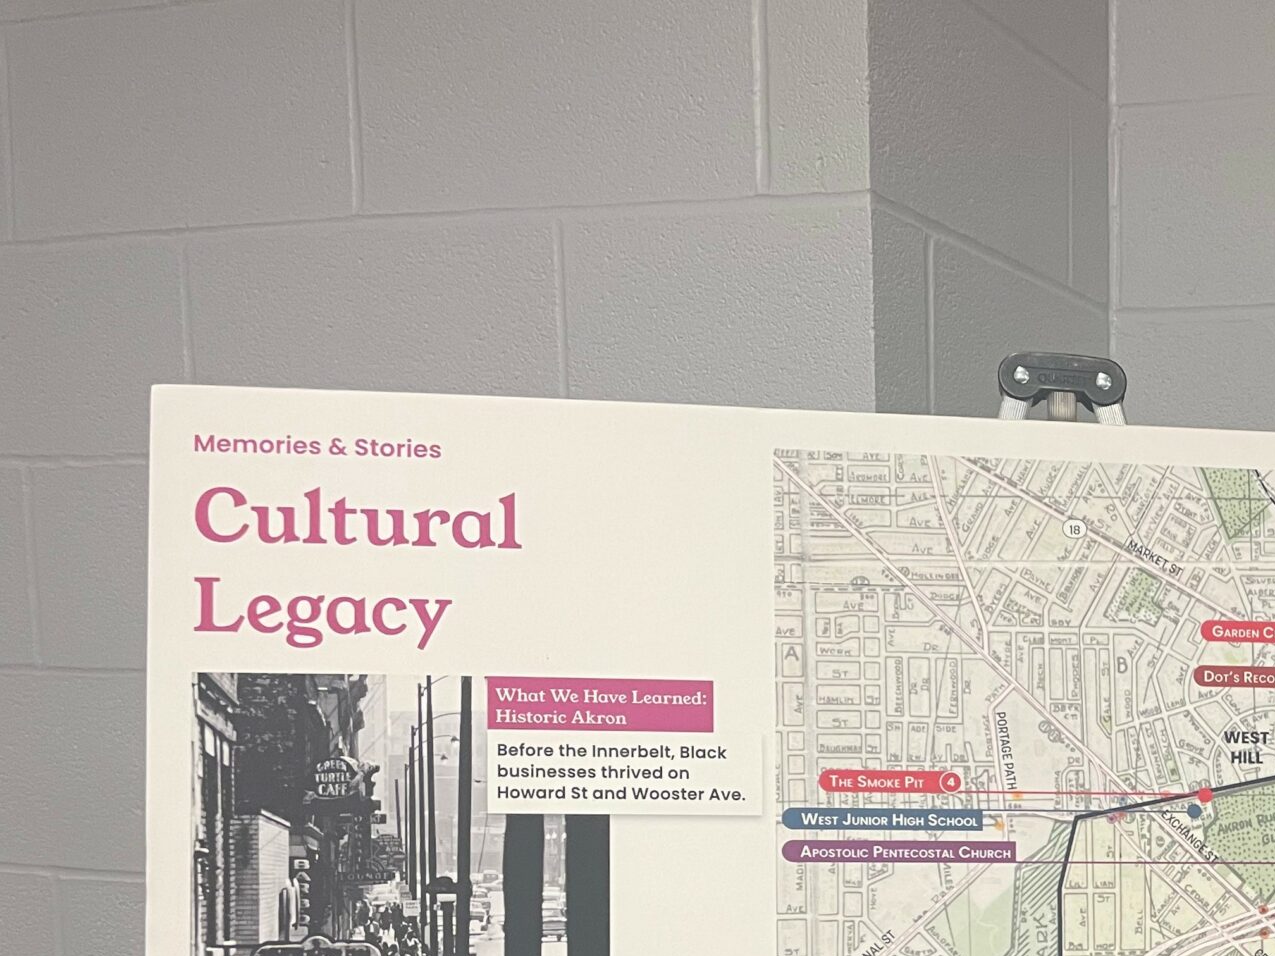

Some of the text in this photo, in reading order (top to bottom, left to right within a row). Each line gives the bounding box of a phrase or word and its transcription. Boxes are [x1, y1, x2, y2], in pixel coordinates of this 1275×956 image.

[194, 434, 442, 458] Memories & Stories
[195, 486, 522, 549] Cultural
[1069, 524, 1081, 534] 18
[1127, 540, 1183, 576] MARKET ST
[193, 577, 453, 650] Legacy
[495, 688, 707, 705] What We Have Learned:
[495, 709, 628, 725] Historic Akron
[1224, 731, 1269, 744] WEST
[497, 743, 727, 760] Before the Innerbelt, Black
[996, 712, 1017, 790] PORTAGE PATH
[1231, 751, 1263, 764] HILL
[497, 764, 689, 780] businesses thrived on
[946, 778, 955, 787] 4
[497, 786, 746, 801] Howard St and Wooster Ave.
[1161, 810, 1219, 863] EXCHANGE ST
[881, 929, 895, 944] ST
